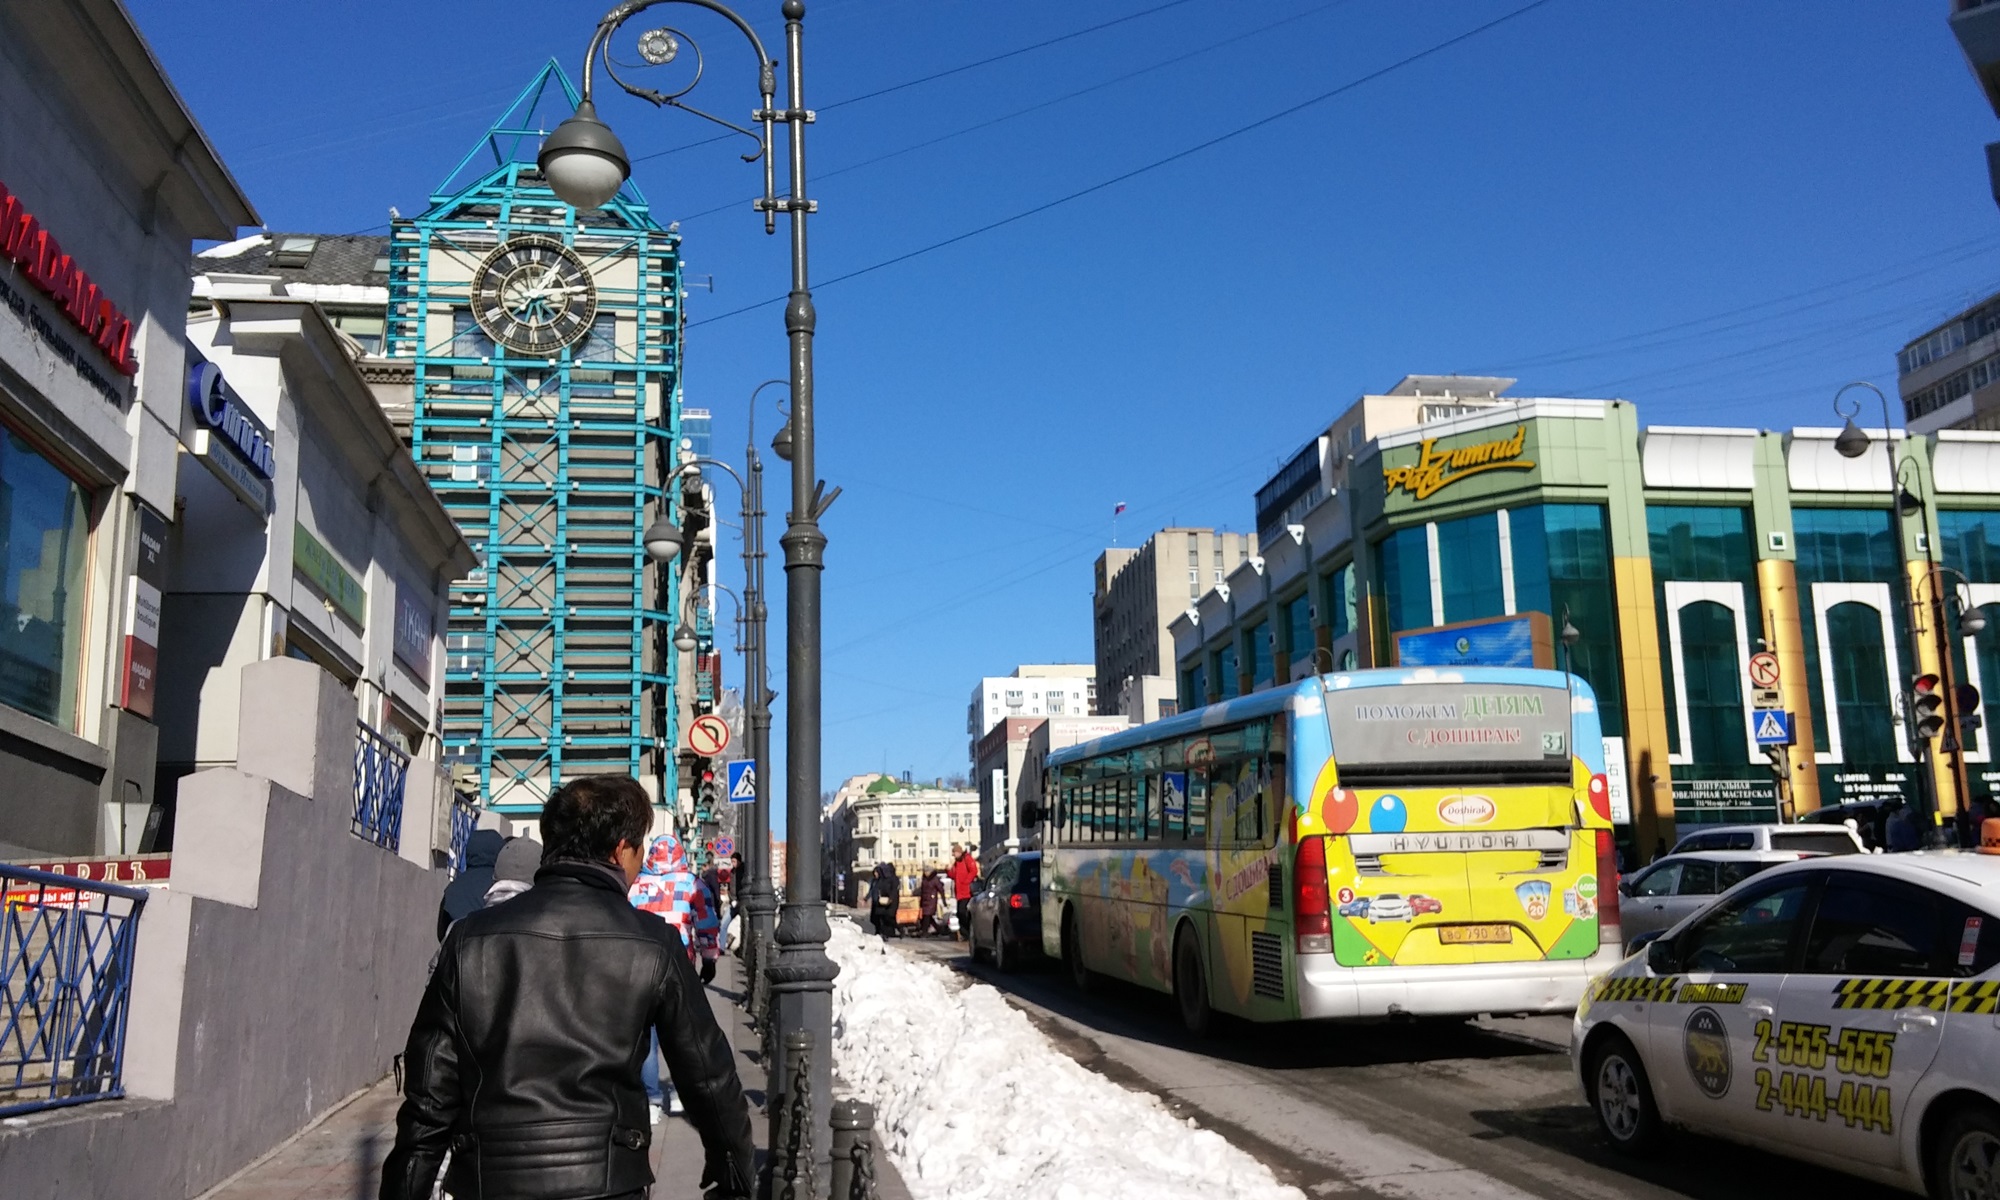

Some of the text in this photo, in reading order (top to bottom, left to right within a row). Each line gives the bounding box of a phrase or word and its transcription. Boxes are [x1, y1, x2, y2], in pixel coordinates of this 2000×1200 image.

[141, 531, 161, 554] MADAM
[147, 550, 156, 564] XL
[132, 661, 152, 680] MADAM
[138, 676, 147, 691] XL
[1355, 694, 1544, 720] ПОМОЖЕМ ДЕТЯМ
[1407, 727, 1521, 748] С ДОШИРАК!
[1543, 733, 1563, 750] 31
[1692, 780, 1750, 790] ЦЕНТРАЛЬНАЯ
[1722, 789, 1773, 799] МАСТЕРСКАЯ
[1448, 805, 1487, 816] Doshirak
[1393, 834, 1532, 849] HYUNDAI
[1579, 883, 1597, 891] 6000
[1342, 890, 1350, 901] 3
[1530, 905, 1544, 916] 20
[1752, 1019, 1896, 1079] 2-555-555
[1755, 1067, 1893, 1135] 2-444-444
